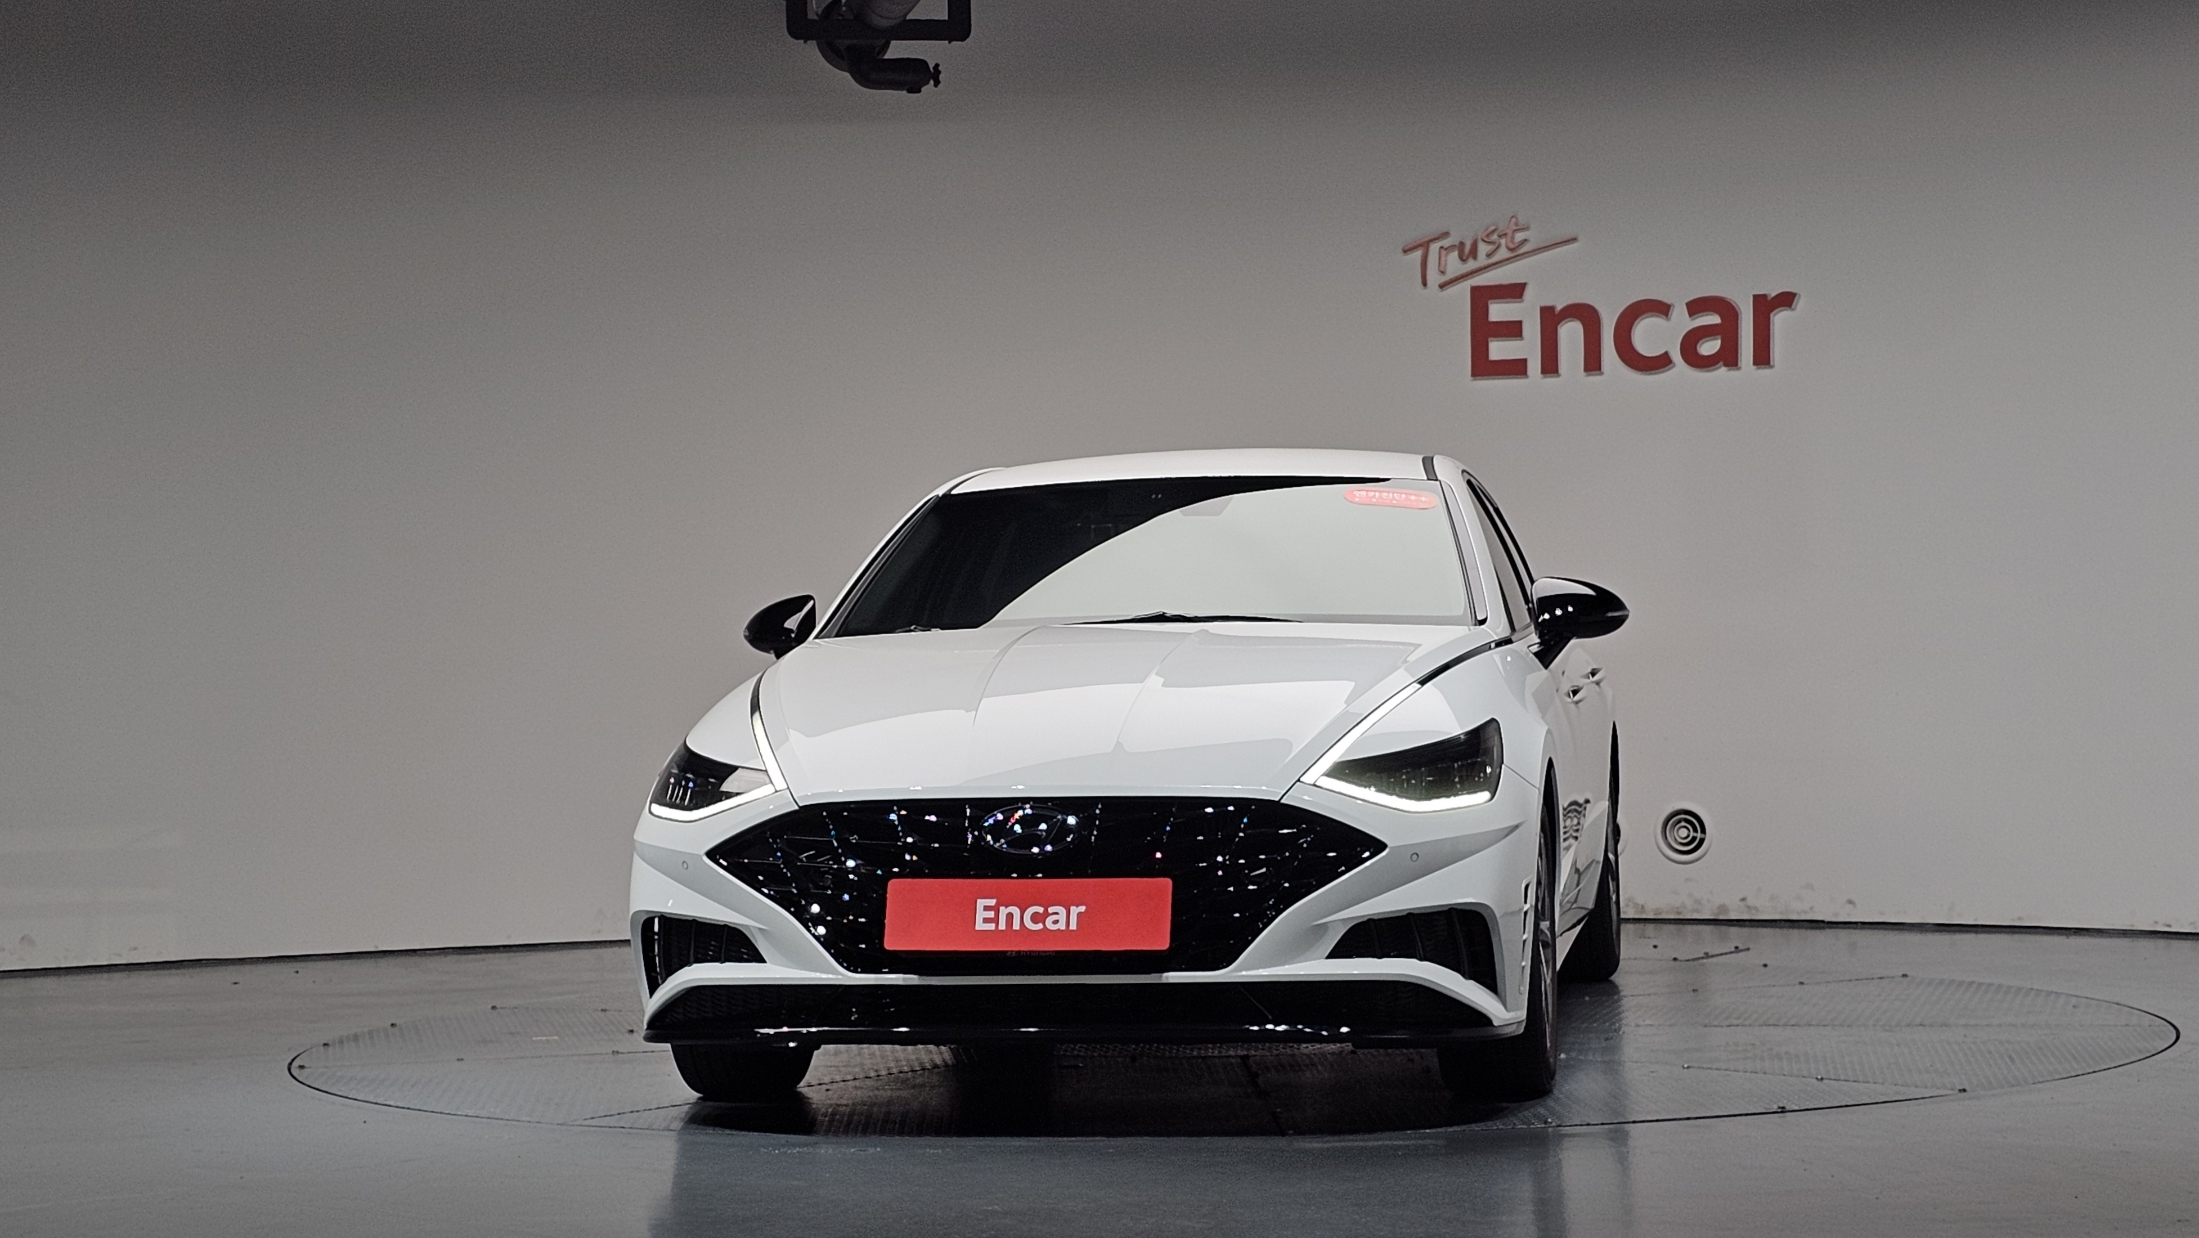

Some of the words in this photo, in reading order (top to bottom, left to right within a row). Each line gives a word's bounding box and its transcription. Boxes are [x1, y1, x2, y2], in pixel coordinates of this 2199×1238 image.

[1402, 215, 1531, 289] Trust
[1470, 282, 1799, 380] Encar
[974, 898, 1087, 931] Encar
